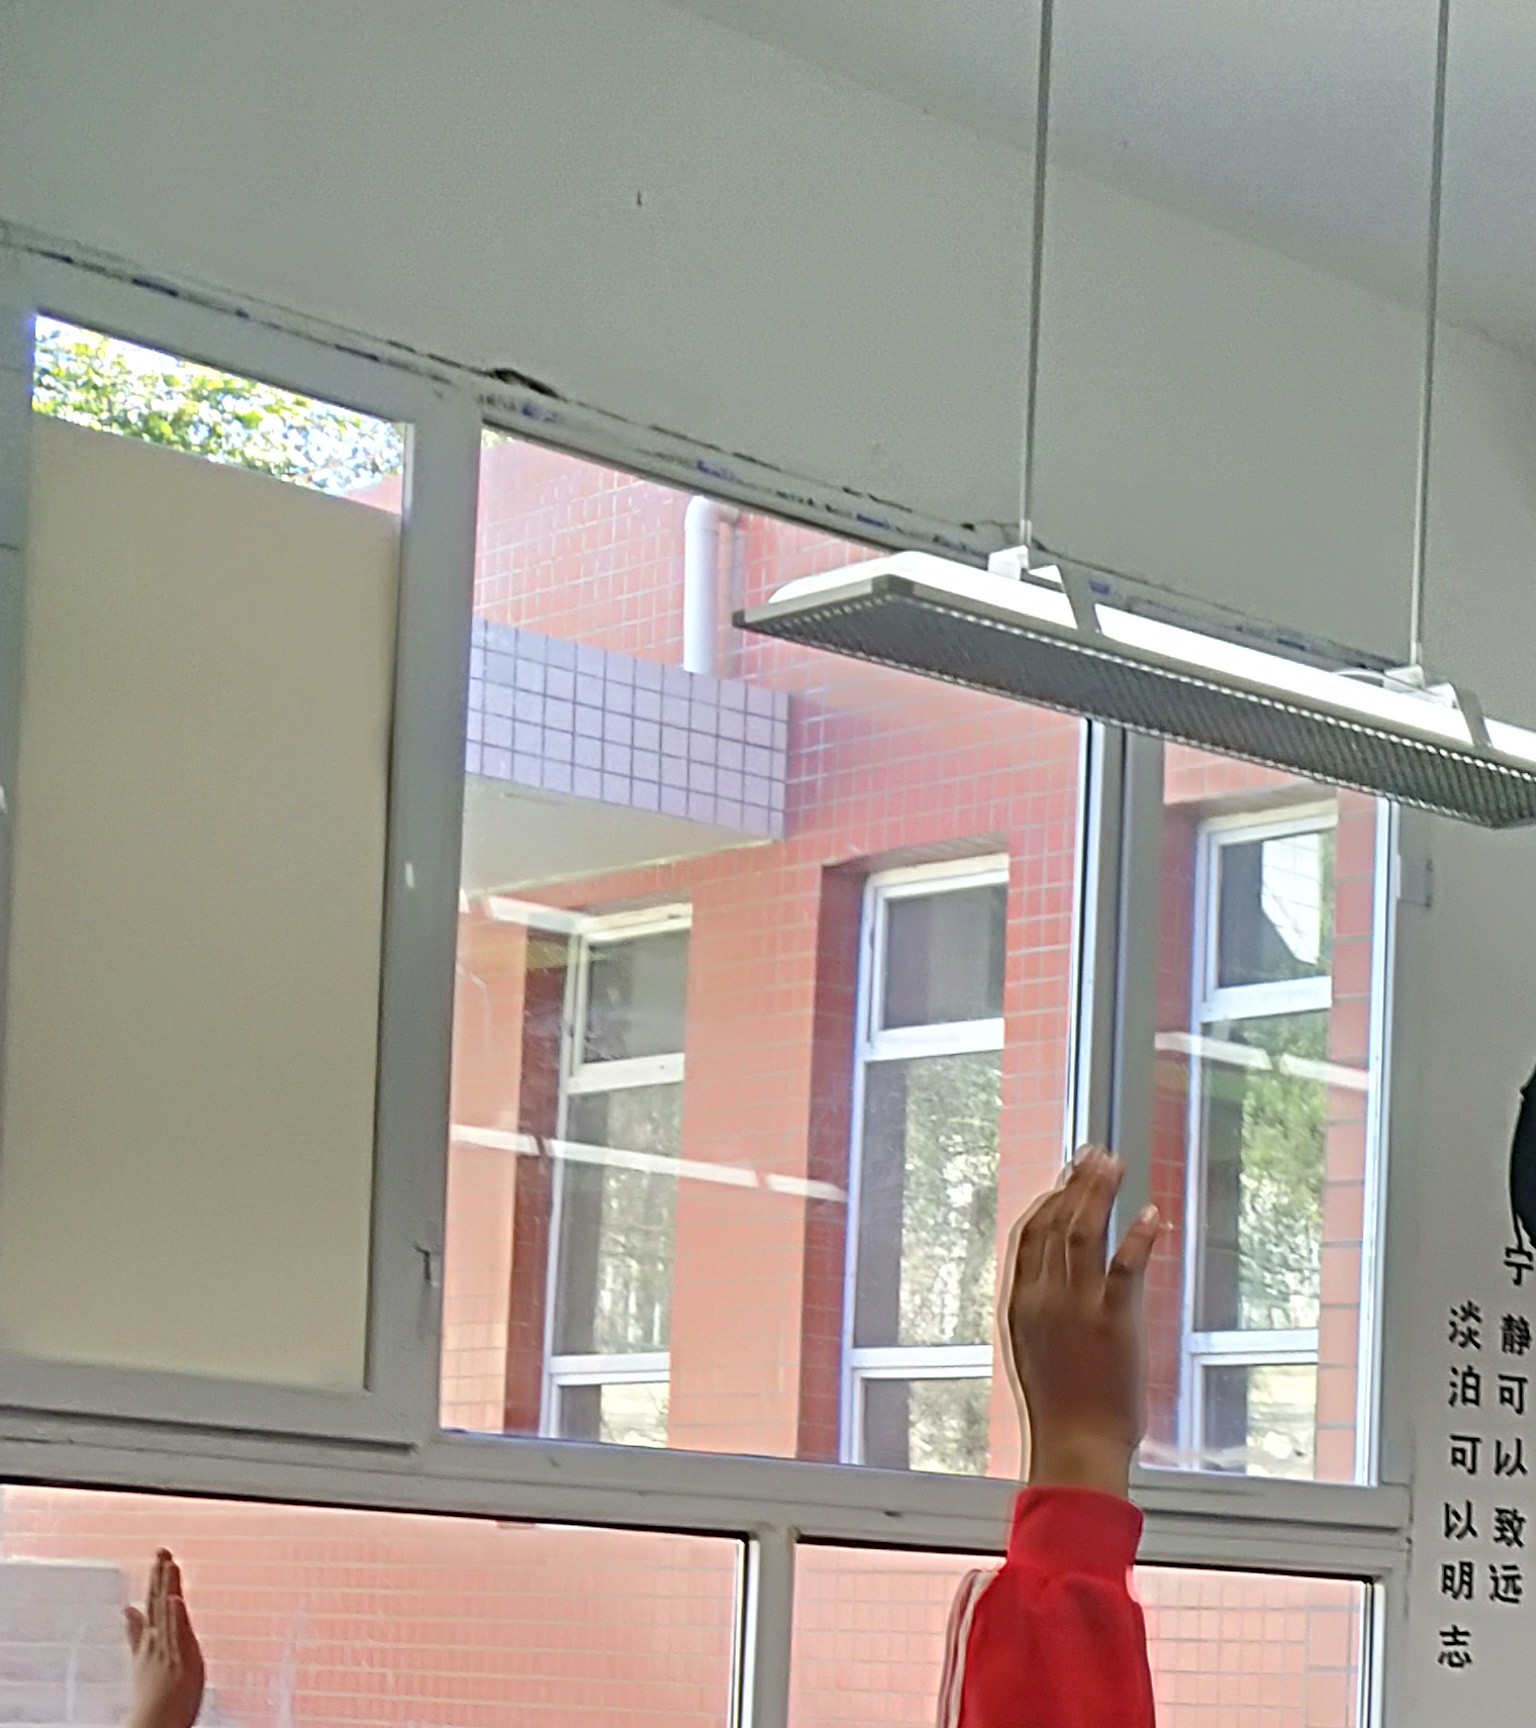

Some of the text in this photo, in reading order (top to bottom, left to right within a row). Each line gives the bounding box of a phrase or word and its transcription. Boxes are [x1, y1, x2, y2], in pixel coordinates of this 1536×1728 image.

[1437, 1301, 1483, 1669] 淡泊可以明志
[1488, 1246, 1533, 1604] 宁静可以致远
